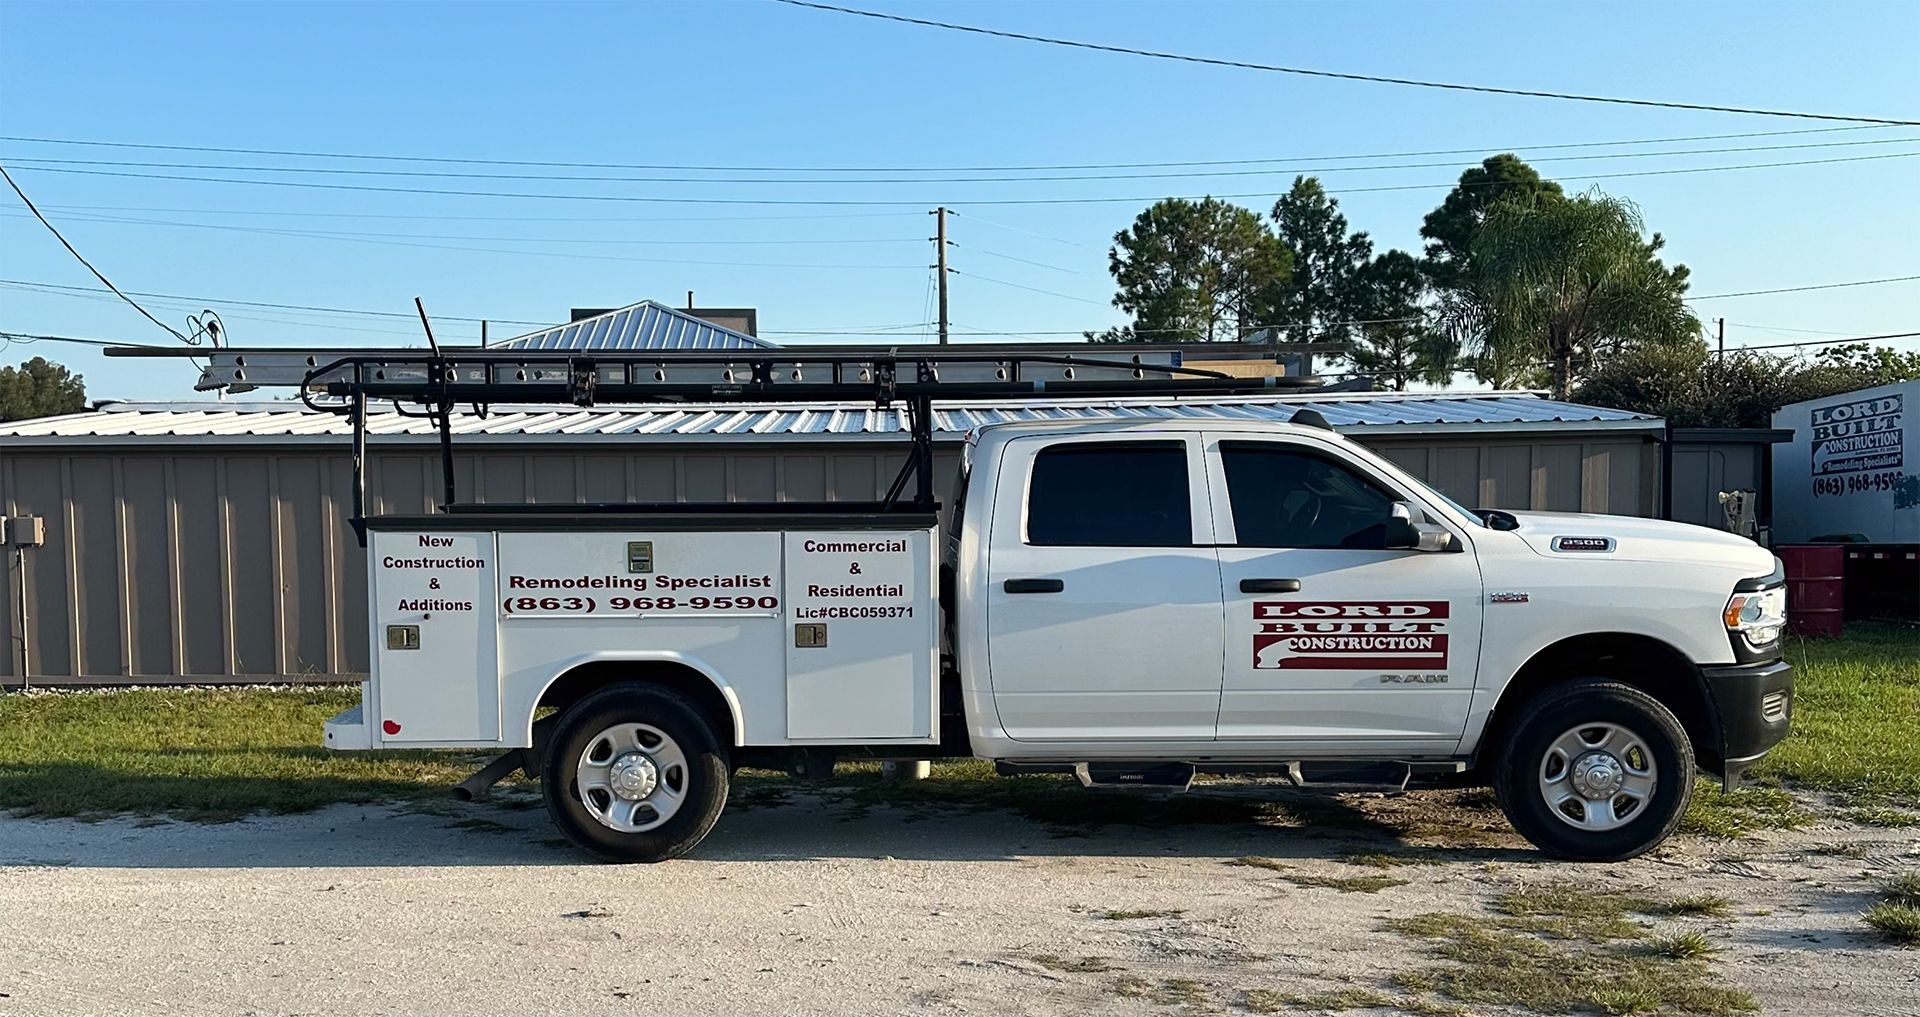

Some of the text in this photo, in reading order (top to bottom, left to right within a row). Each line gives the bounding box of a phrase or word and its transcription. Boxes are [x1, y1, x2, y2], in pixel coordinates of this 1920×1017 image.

[1814, 398, 1899, 425] LORD
[1813, 415, 1901, 440] BUILT
[1825, 432, 1899, 454] CONSTRUCTION
[1812, 476, 1845, 498] (863)
[418, 535, 454, 548] New
[804, 540, 907, 553] Commercial
[383, 557, 485, 569] Construction
[849, 562, 862, 575] &
[429, 578, 441, 590] &
[509, 574, 772, 592] Remodeling Specialist
[808, 585, 903, 598] Residential
[398, 598, 473, 611] Additions
[503, 596, 779, 614] (863) 968-9590
[1262, 605, 1432, 617] LORD
[796, 606, 914, 620] Lic#CBC059371
[1259, 622, 1446, 634] BUILT
[1288, 637, 1433, 650] CONSTRUCTION
[1379, 674, 1449, 684] RAM
